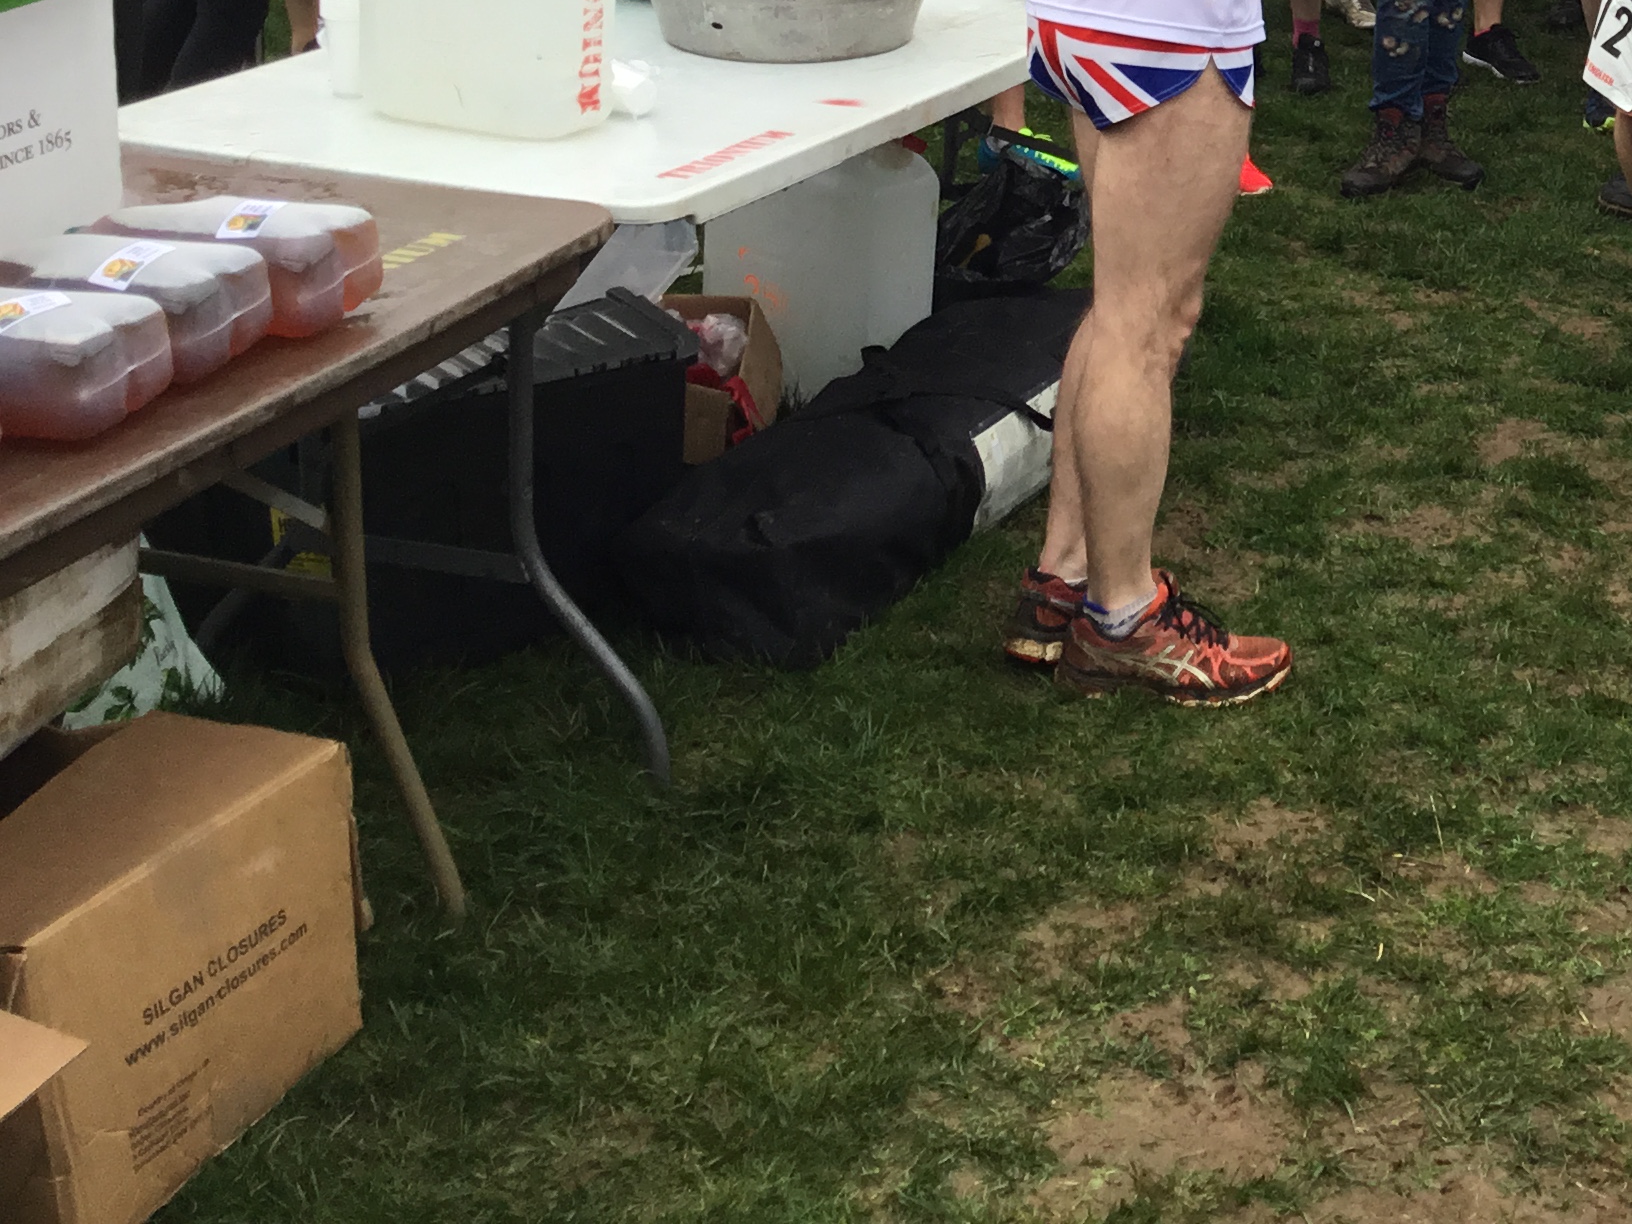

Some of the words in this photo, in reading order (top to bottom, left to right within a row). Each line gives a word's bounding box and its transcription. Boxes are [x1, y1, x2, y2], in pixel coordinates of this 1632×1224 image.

[27, 109, 42, 129] &
[39, 128, 72, 156] 1865
[124, 921, 308, 1068] www.silgan-closures.com
[142, 970, 205, 1026] SILGAN
[206, 908, 288, 978] CLOSURES
